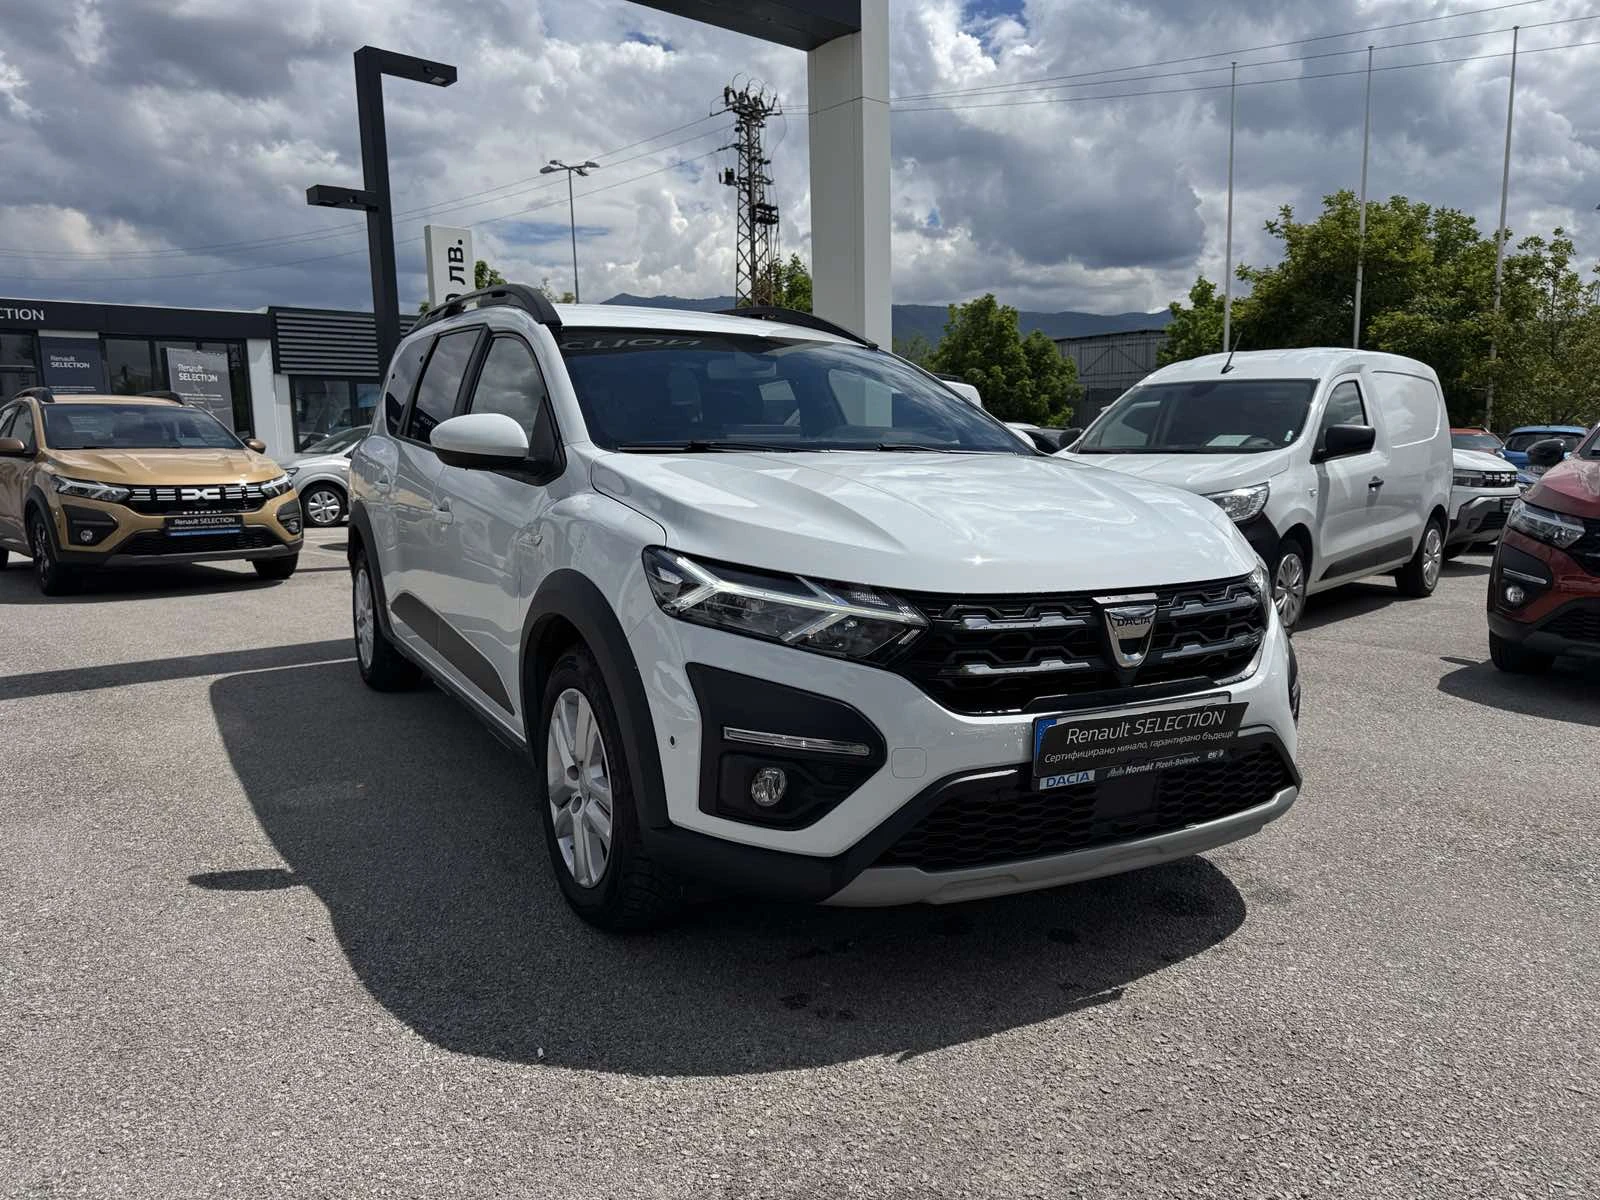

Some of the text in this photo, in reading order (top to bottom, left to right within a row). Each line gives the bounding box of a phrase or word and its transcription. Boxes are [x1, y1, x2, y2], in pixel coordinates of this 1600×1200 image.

[50, 354, 76, 362] Renault
[177, 363, 203, 373] Renault
[178, 373, 218, 383] SELECTION
[174, 517, 236, 526] Renault SELECTION
[1117, 615, 1151, 627] DACIA
[1066, 709, 1226, 745] Renault SELECTION
[1044, 746, 1116, 764] Сертифицирано
[1116, 740, 1148, 754] минало,
[1149, 734, 1201, 749] гарантирано
[1046, 772, 1091, 788] DACIA
